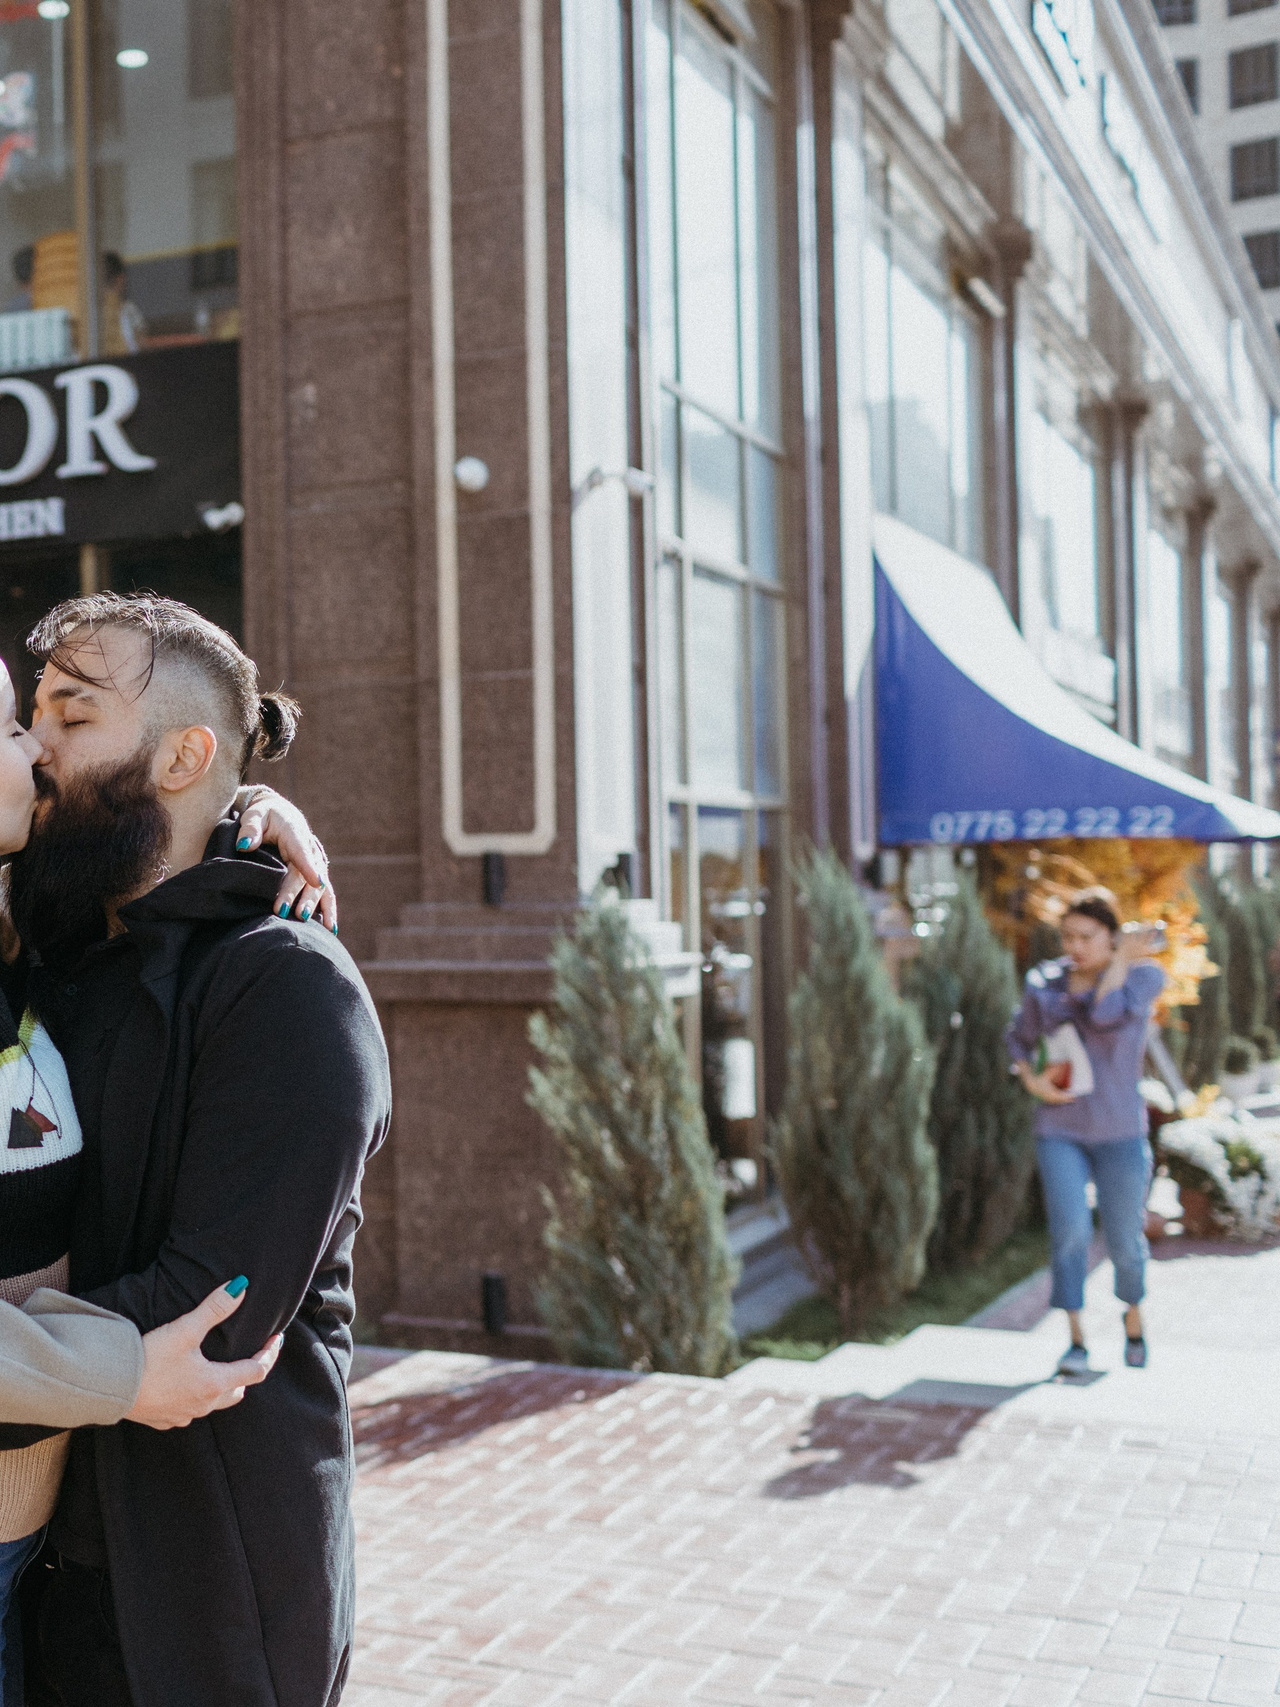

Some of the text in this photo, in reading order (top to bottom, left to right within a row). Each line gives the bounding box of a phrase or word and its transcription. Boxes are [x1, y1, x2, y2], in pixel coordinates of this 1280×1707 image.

[929, 804, 1175, 843] 0775 22 22 22
